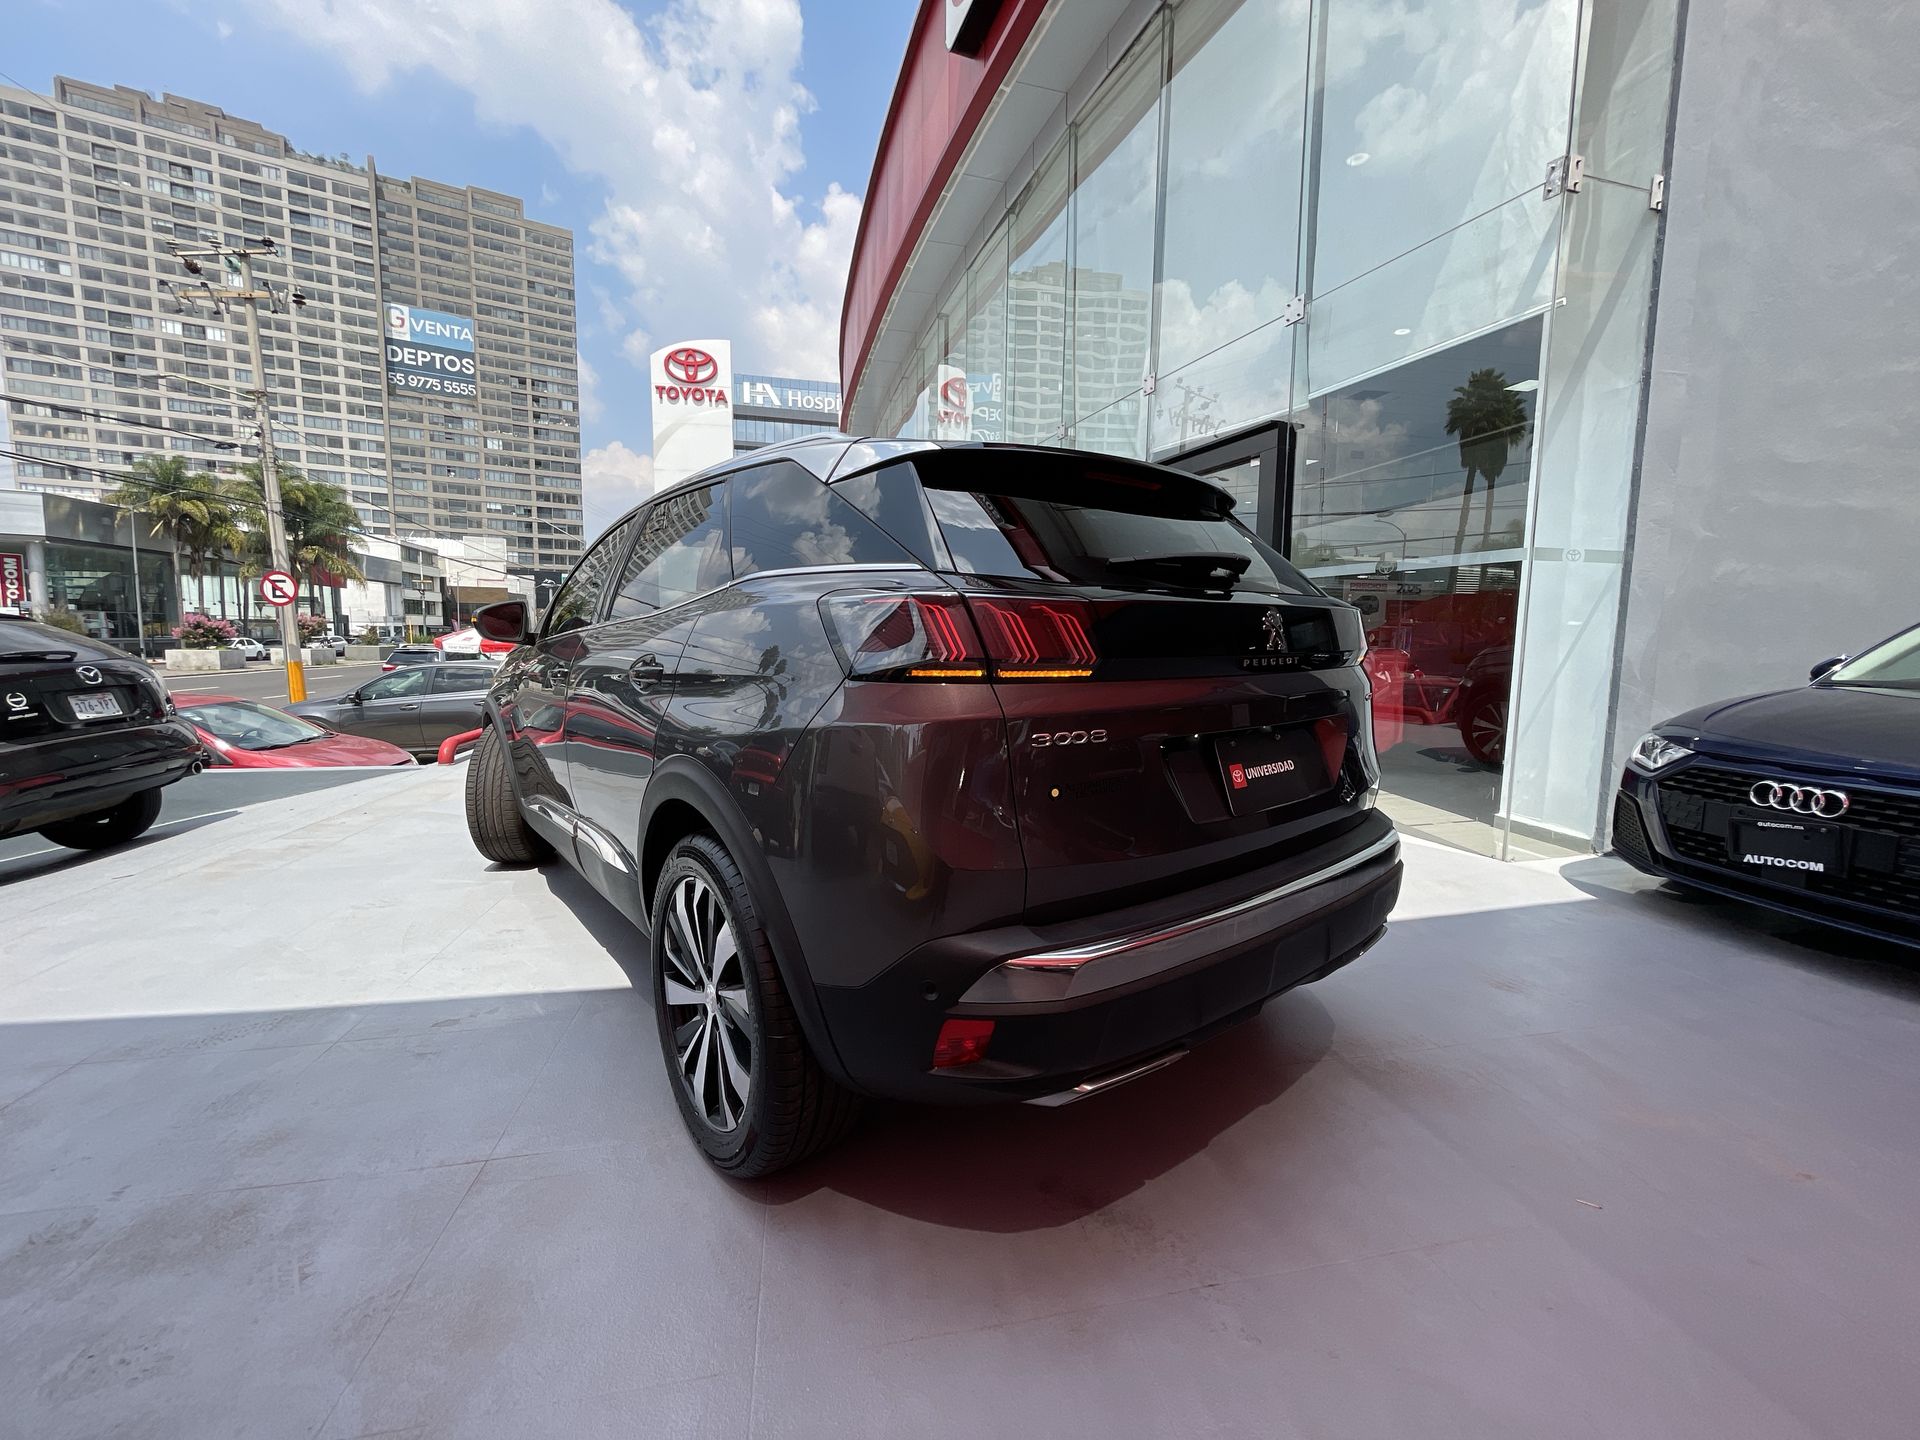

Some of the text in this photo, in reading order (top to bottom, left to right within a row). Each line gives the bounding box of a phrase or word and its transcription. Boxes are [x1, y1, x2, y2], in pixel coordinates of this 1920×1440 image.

[410, 318, 474, 342] VENTA
[386, 345, 475, 374] DEPTOS
[388, 371, 477, 396] 55 9775 5555
[655, 385, 729, 405] TOYOTA
[1243, 656, 1300, 667] PEUGEOT
[1031, 729, 1108, 748] 3008
[1244, 759, 1295, 780] UNIVERSIDAD
[1743, 853, 1824, 872] AUTOCOM
